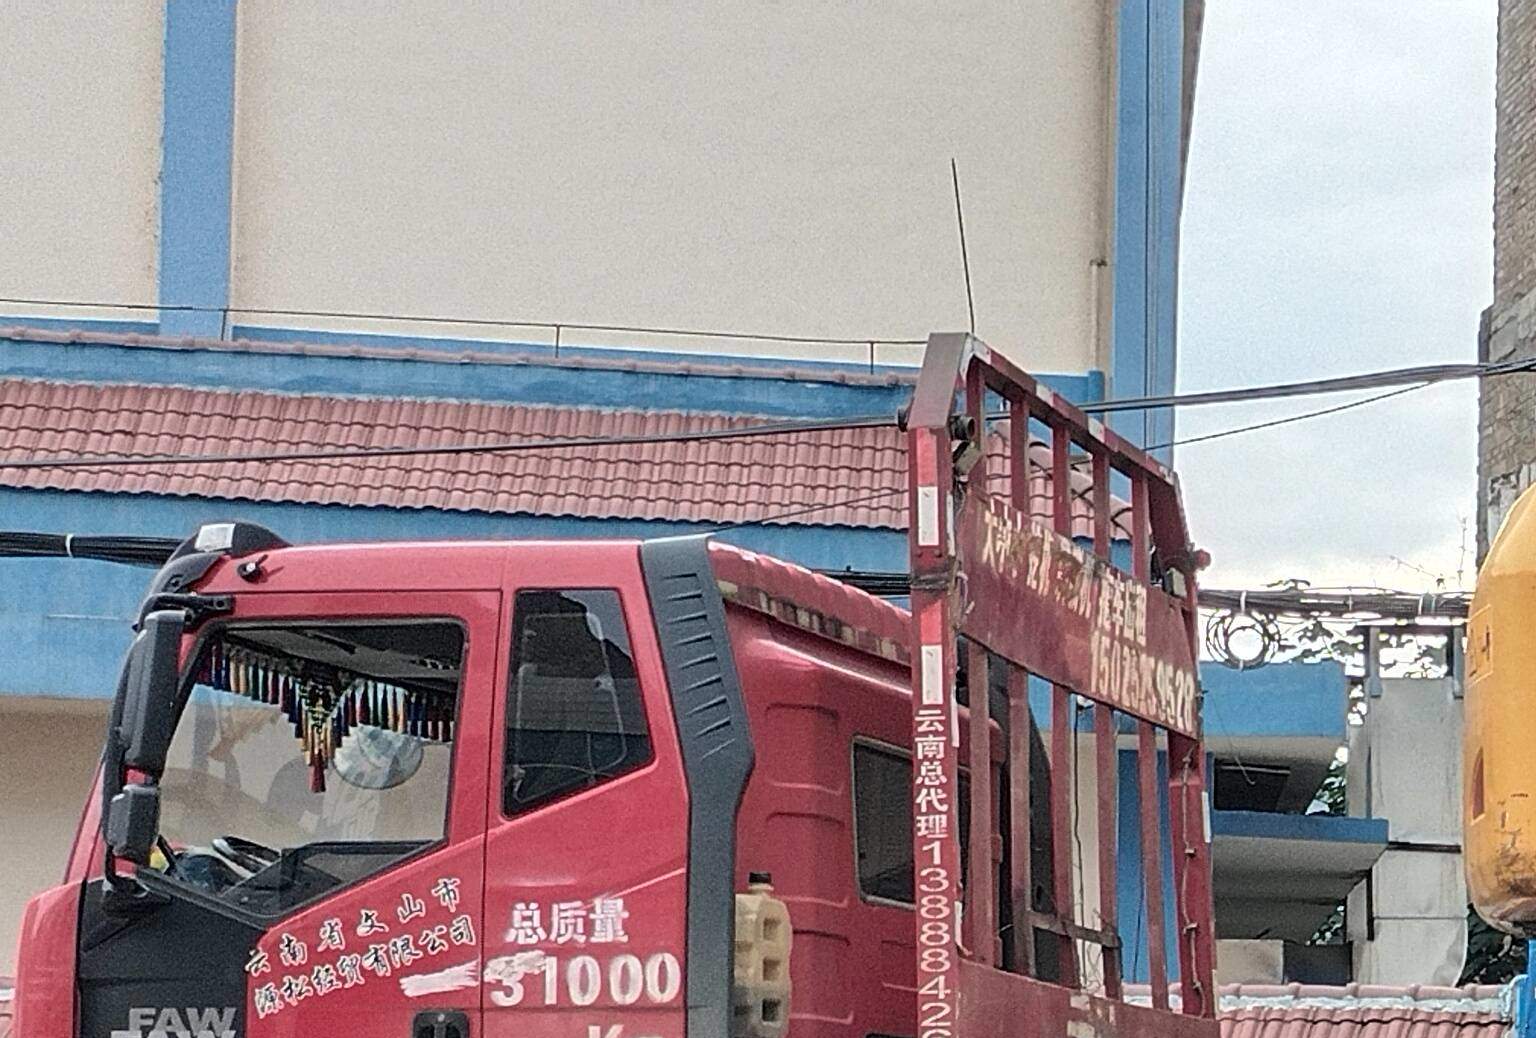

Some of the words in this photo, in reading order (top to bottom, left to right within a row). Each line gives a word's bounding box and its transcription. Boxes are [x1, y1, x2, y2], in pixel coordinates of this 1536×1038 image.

[245, 878, 460, 977] 云南省文山市
[505, 897, 629, 944] 总质量
[485, 950, 681, 1006] 31000
[129, 1007, 236, 1037] FAW
